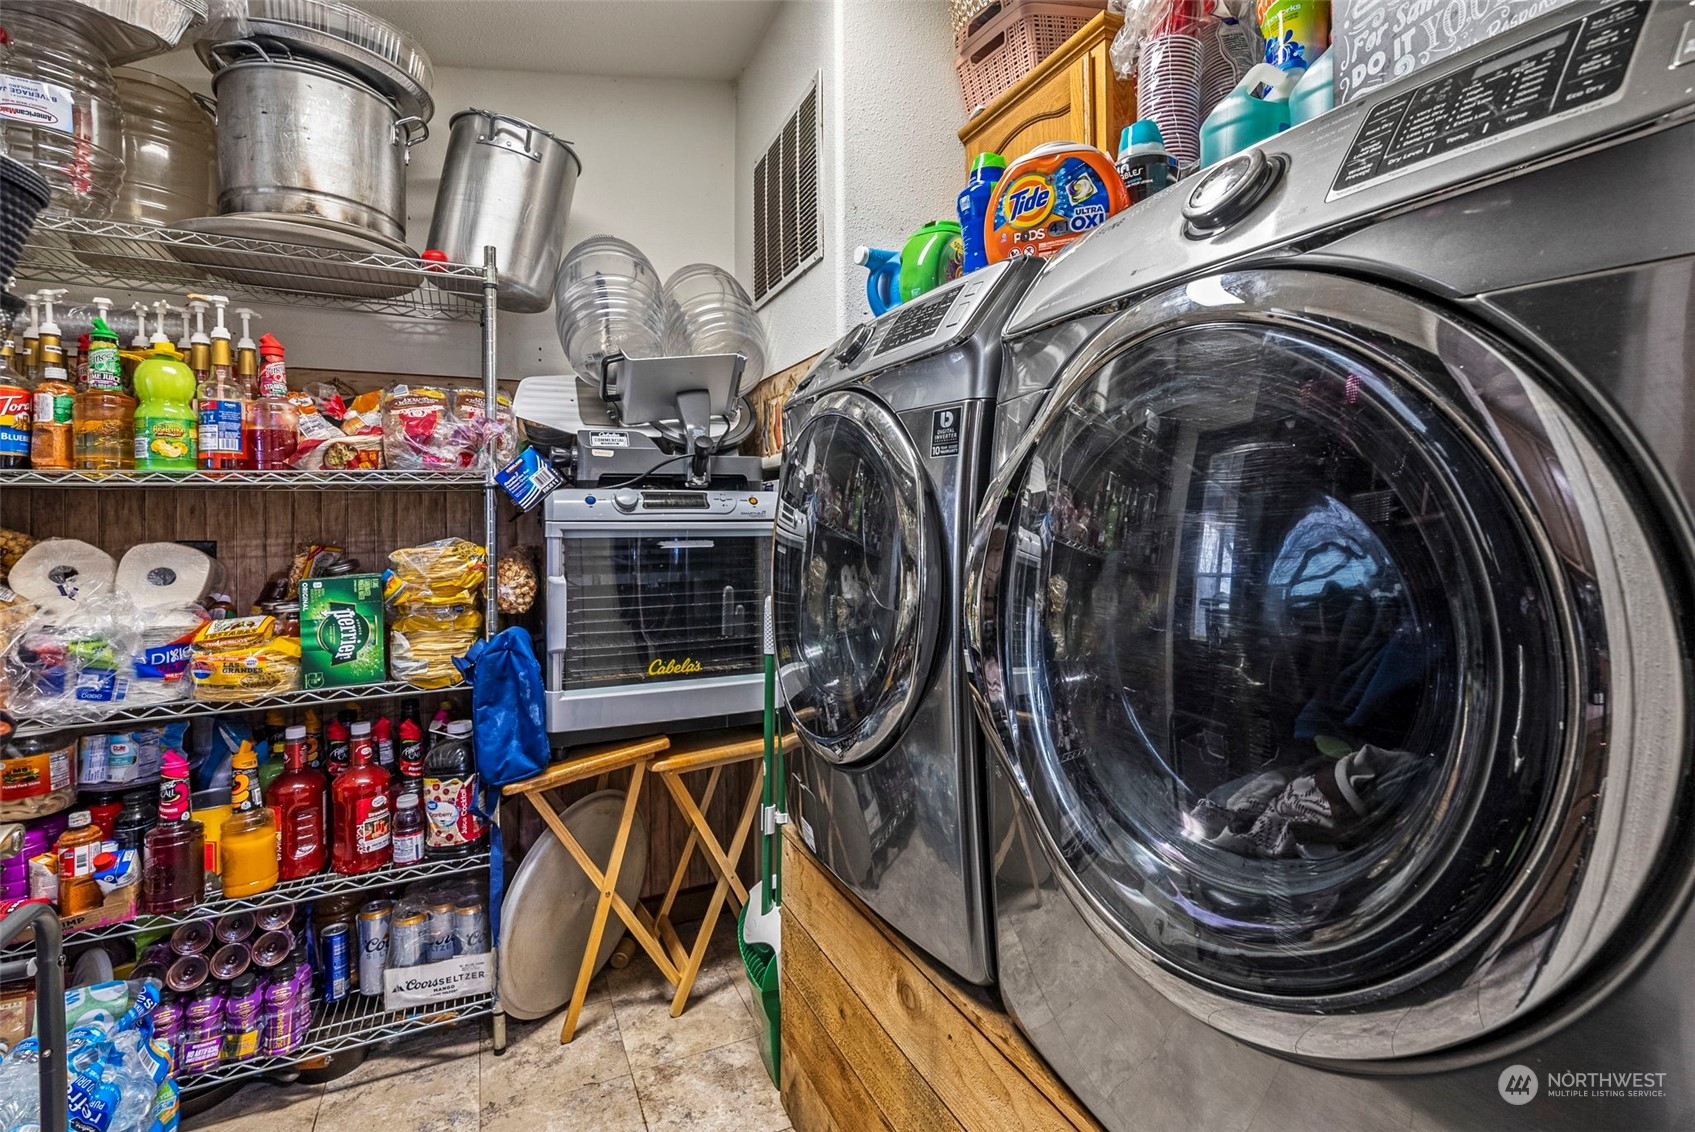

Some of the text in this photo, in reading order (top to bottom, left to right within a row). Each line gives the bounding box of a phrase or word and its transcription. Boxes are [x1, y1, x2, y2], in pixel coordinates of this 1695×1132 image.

[1352, 22, 1388, 63] For
[1352, 51, 1386, 89] DO
[1393, 27, 1416, 62] IT
[1585, 83, 1606, 95] Dry
[1433, 103, 1447, 111] Dry
[1431, 109, 1446, 117] Dry
[1435, 113, 1450, 122] Dry
[1381, 121, 1395, 130] Dry
[1421, 125, 1436, 133] Dry
[1423, 130, 1438, 139] Dry
[1387, 147, 1425, 166] Dry Level
[1009, 185, 1050, 223] Tide
[1075, 206, 1103, 215] ULTRA
[1070, 213, 1105, 231] OXI
[932, 446, 940, 456] 10
[648, 657, 702, 676] Cabela's
[405, 971, 485, 991] Coors SELTZER
[433, 985, 455, 993] MANGO
